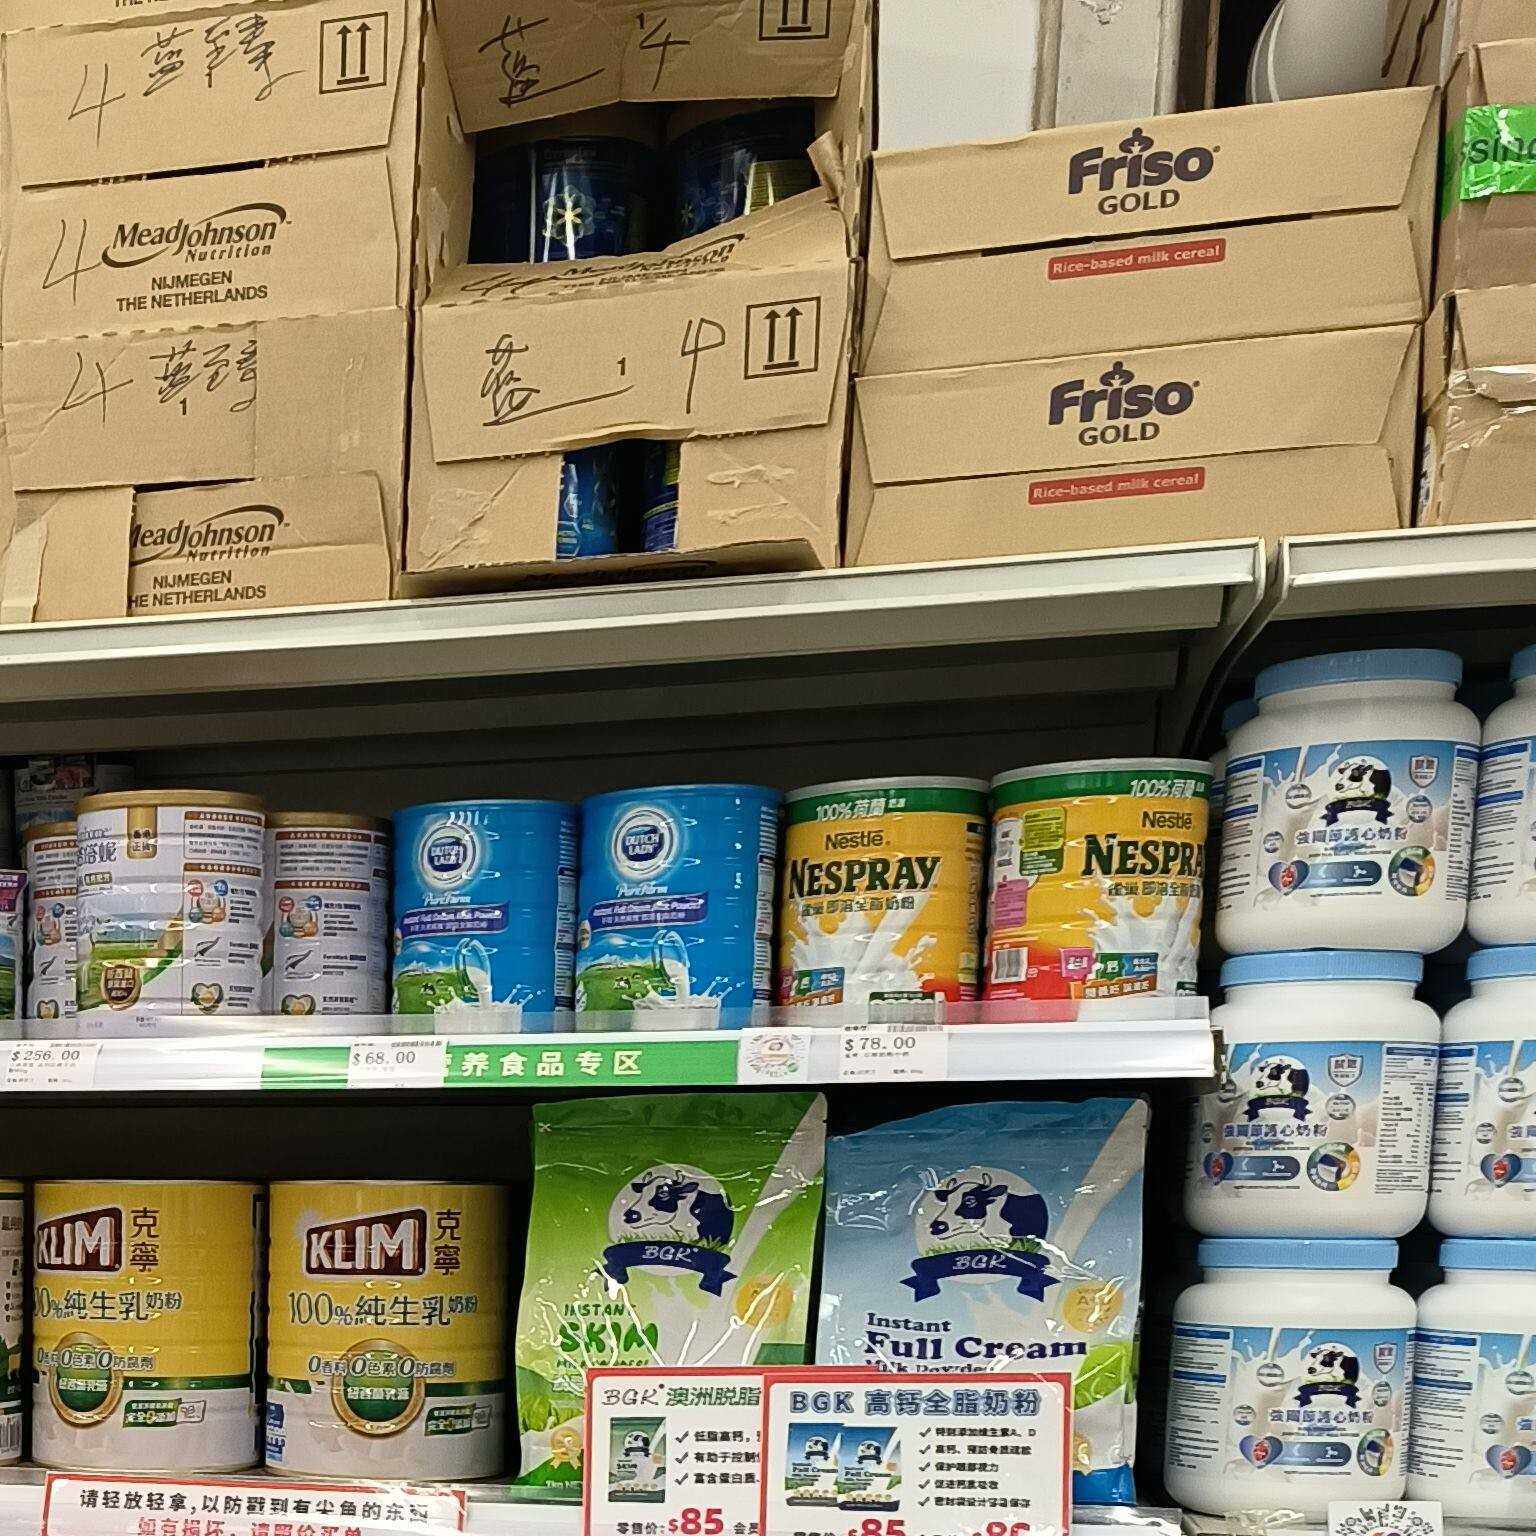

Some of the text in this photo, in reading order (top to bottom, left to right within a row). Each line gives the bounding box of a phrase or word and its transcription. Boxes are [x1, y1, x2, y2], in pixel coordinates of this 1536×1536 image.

[1068, 144, 1215, 195] Friso
[1098, 190, 1181, 215] GOLD
[113, 219, 277, 255] MeadJohnson
[185, 244, 271, 263] Nutrition
[1052, 244, 1220, 276] Rice-based milk cereal
[151, 271, 232, 290] NIJMEGEN
[117, 286, 268, 311] THE NETHERLANDS
[1048, 376, 1195, 426] Friso
[1079, 422, 1161, 446] GOLD
[1033, 474, 1200, 504] Rice-based milk cereal
[187, 545, 270, 562] Nutrition
[153, 570, 232, 588] NIJMEGEN
[152, 585, 266, 605] NETHERLANDS
[789, 856, 943, 899] NESPRAY
[844, 1036, 916, 1052] $78.00
[37, 1216, 114, 1267] KLIM
[130, 1208, 160, 1273] 克寧
[310, 1218, 415, 1271] KLIM
[434, 1208, 462, 1276] 克寧
[643, 1244, 694, 1263] BGK
[953, 1253, 1008, 1271] BGK
[866, 1311, 952, 1334] Instant
[864, 1330, 1088, 1361] Full Cream
[602, 1387, 658, 1407] BGK
[790, 1388, 1041, 1417] BGK 高钙全脂奶粉
[668, 1507, 724, 1535] $85
